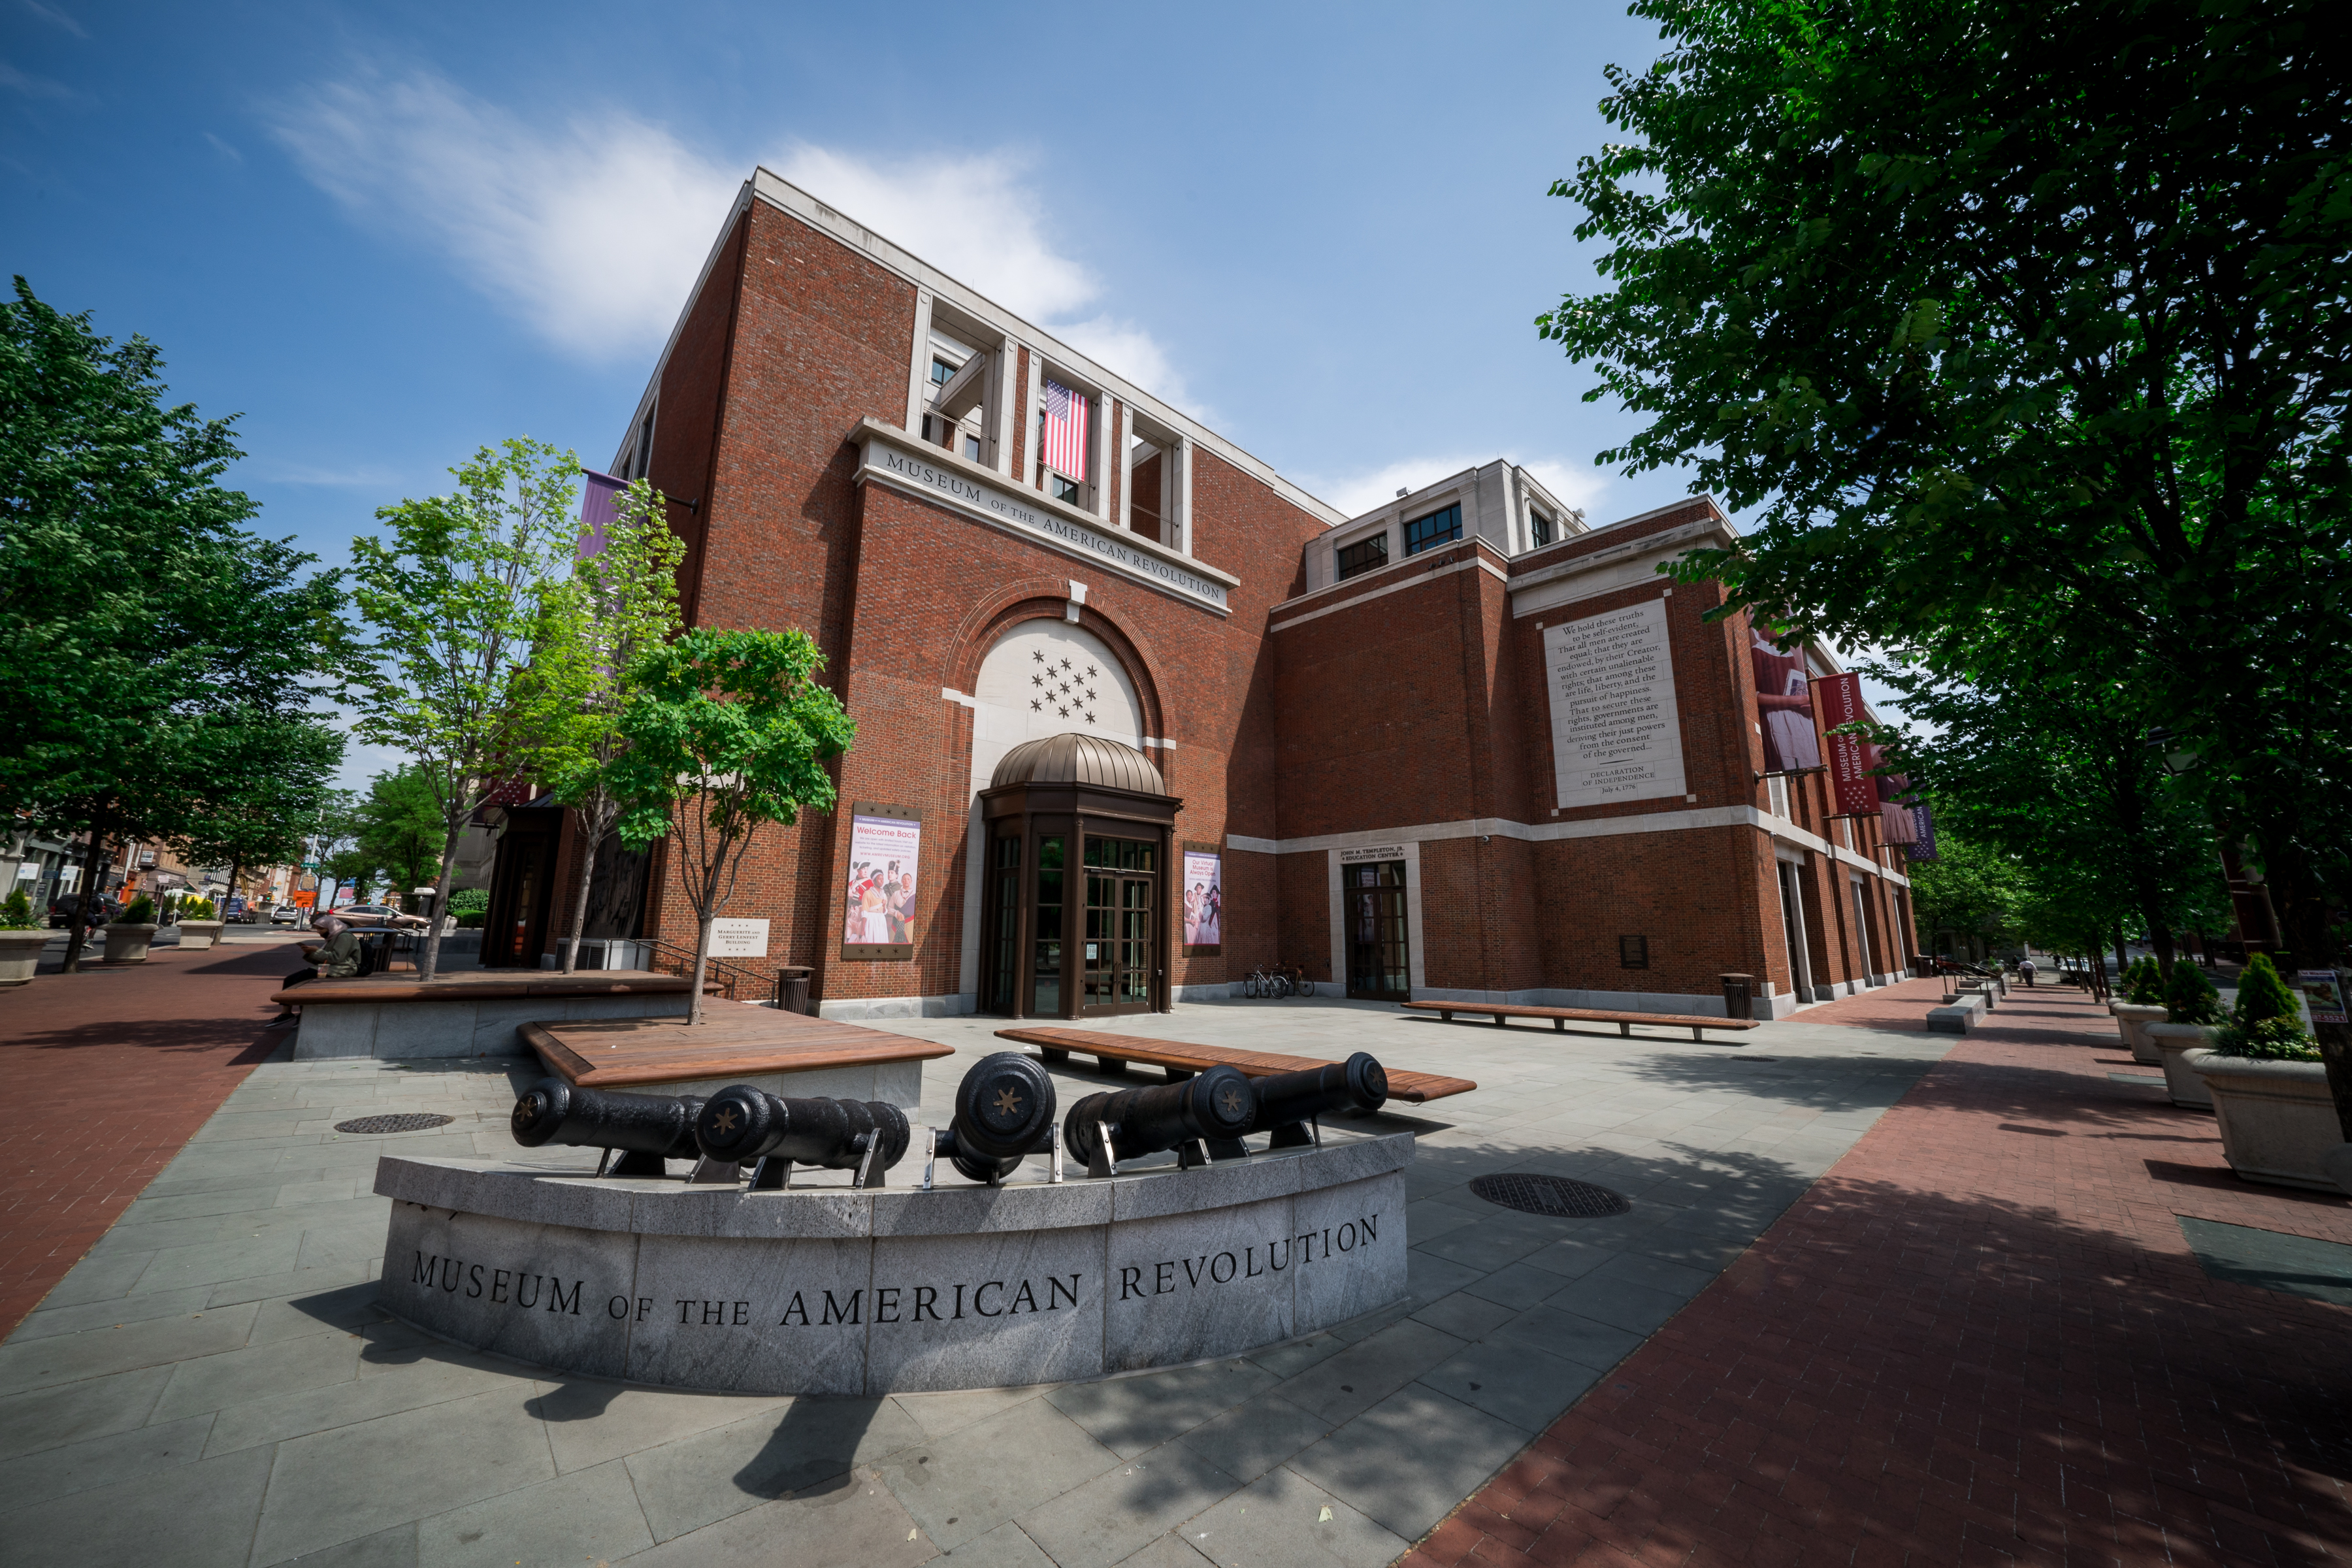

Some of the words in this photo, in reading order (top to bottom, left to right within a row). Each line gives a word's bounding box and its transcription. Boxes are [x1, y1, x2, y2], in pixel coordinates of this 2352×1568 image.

[886, 453, 981, 502] MUSEUM
[991, 500, 1006, 513] OF
[1011, 507, 1034, 524] THE
[1043, 518, 1126, 561] AMERICAN
[1133, 554, 1219, 600] REVOLUTION
[1563, 625, 1576, 635] We
[1578, 623, 1595, 632] hold
[1597, 617, 1616, 627] these
[1619, 611, 1643, 621] truths
[1593, 622, 1639, 637] self-evident,
[1622, 626, 1650, 639] created
[1558, 659, 1593, 672] endowed,
[1595, 657, 1604, 665] by
[1607, 653, 1624, 661] their
[1627, 645, 1661, 657] Creator,
[1570, 649, 1592, 661] equal;
[1612, 642, 1628, 650] they
[1561, 672, 1577, 680] with
[1580, 666, 1606, 676] certain
[1609, 655, 1654, 670] unalienable
[1561, 680, 1585, 690] rights;
[1605, 671, 1633, 681] among
[1635, 664, 1656, 674] these
[1578, 686, 1593, 694] life,
[1595, 681, 1623, 691] liberty,
[1625, 676, 1640, 685] and
[1570, 696, 1597, 708] pursuit
[1610, 687, 1652, 698] happiness.
[1603, 700, 1627, 710] secure
[1630, 696, 1652, 704] these
[1840, 678, 1855, 725] EVOLUTION
[1568, 716, 1592, 725] rights,
[1593, 706, 1644, 722] governments
[1570, 721, 1607, 732] instituted
[1609, 716, 1635, 726] among
[1637, 712, 1658, 721] men,
[1567, 733, 1597, 743] deriving
[1599, 729, 1617, 738] their
[1619, 727, 1634, 737] just
[1637, 723, 1665, 734] powers
[1617, 734, 1650, 744] consent
[1838, 743, 1851, 781] MUSEUM
[1848, 733, 1863, 779] AMERICAN
[1590, 766, 1644, 778] DECLARATION
[1595, 772, 1654, 785] INDEPENDENCE
[857, 826, 894, 836] Welcome
[1917, 807, 1927, 838] AMERICAN
[412, 1250, 584, 1315] MUSEUM
[608, 1294, 653, 1322] OF
[676, 1299, 750, 1326] THE
[779, 1273, 1082, 1326] AMERICAN
[1119, 1214, 1379, 1301] REVOLUTION
